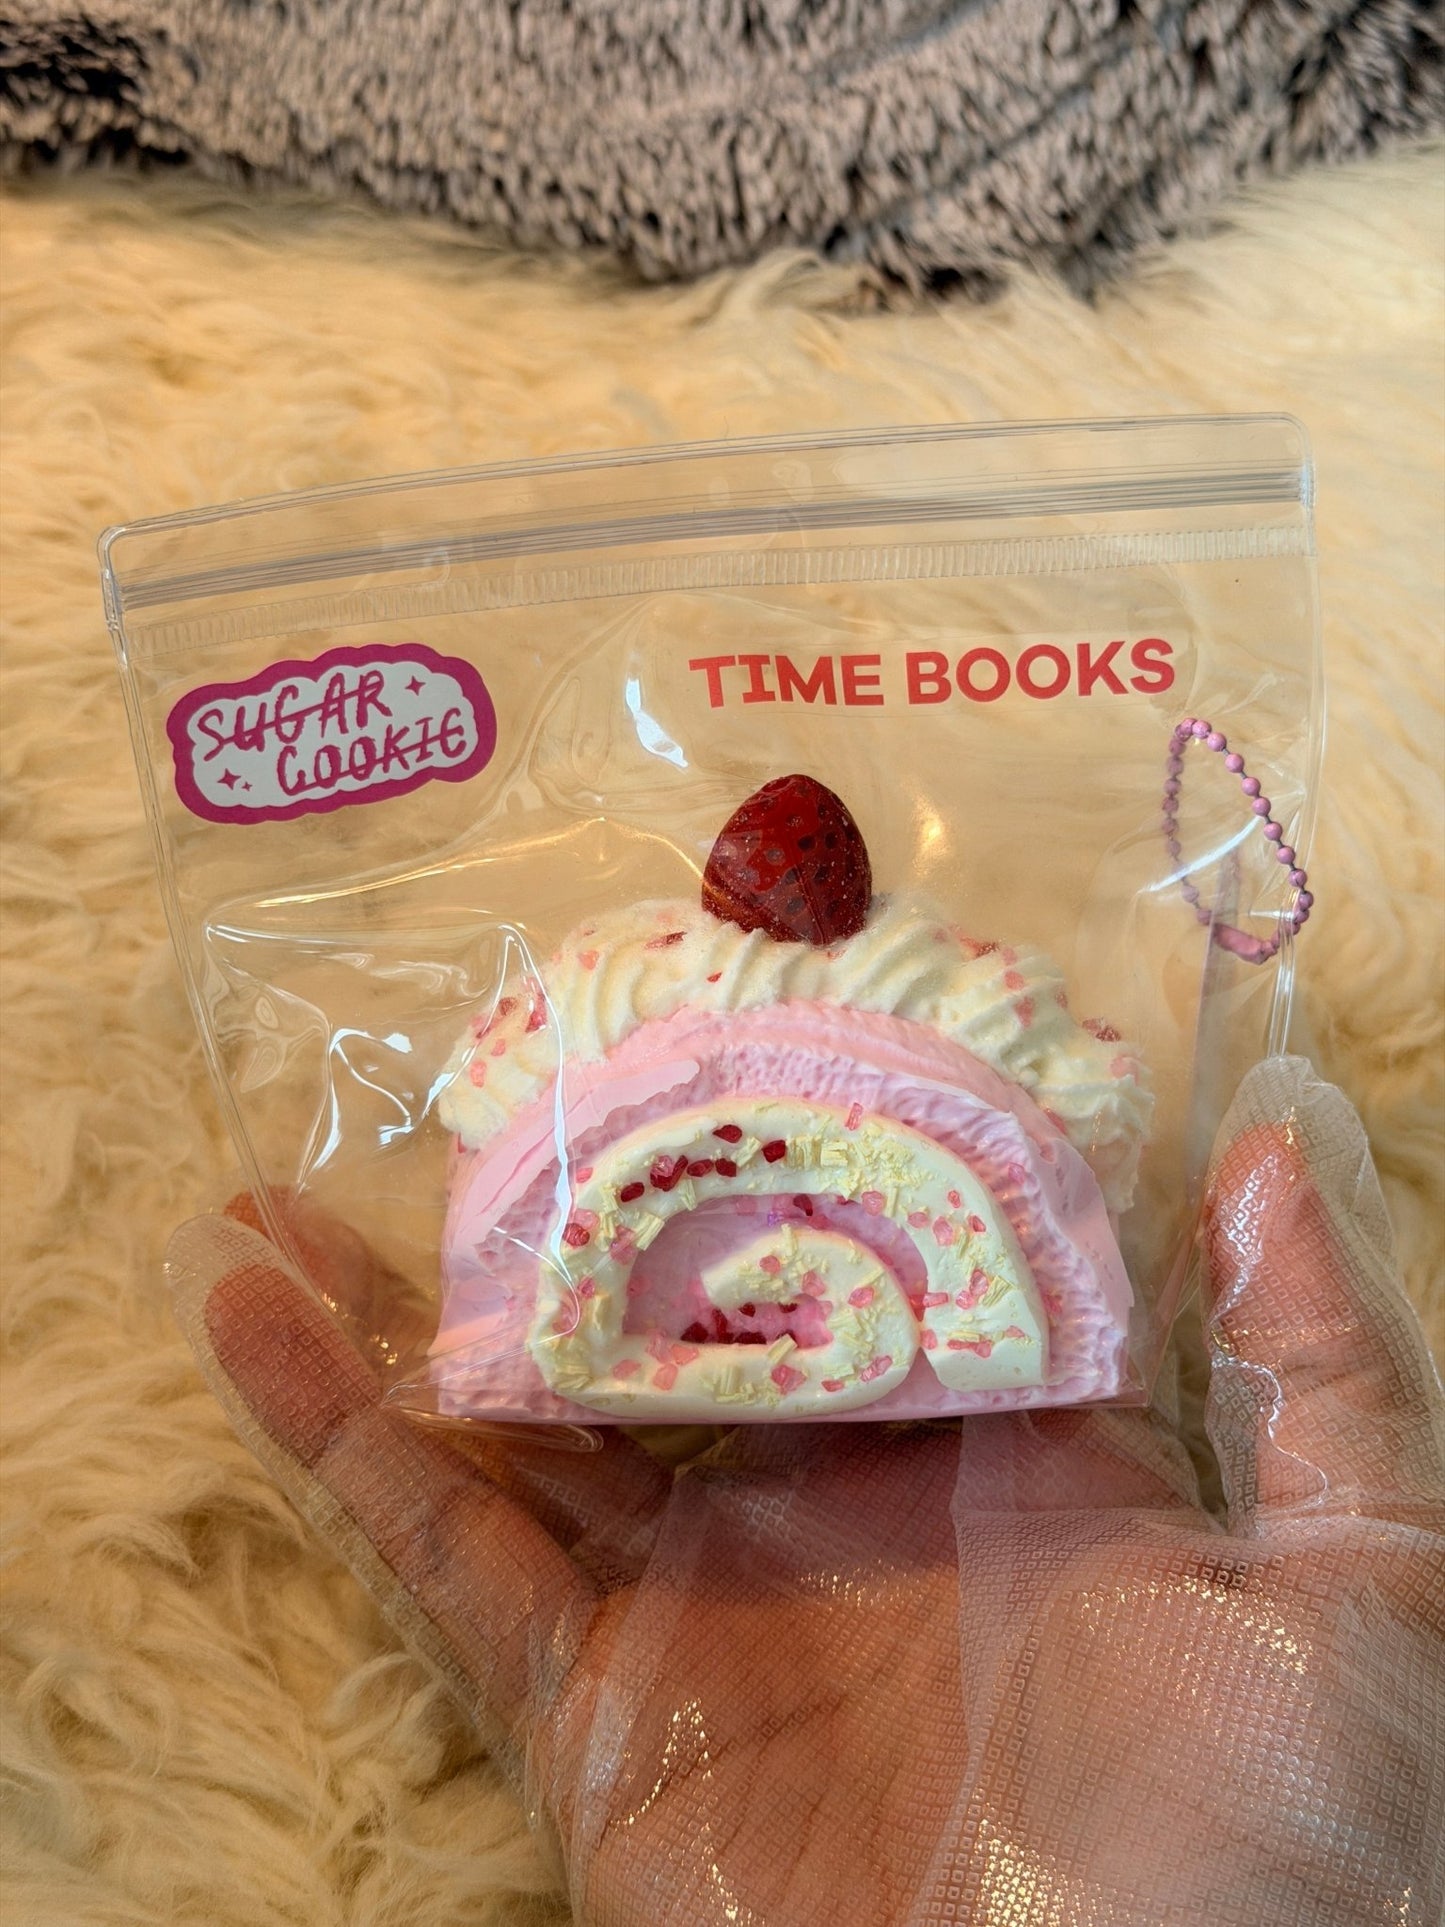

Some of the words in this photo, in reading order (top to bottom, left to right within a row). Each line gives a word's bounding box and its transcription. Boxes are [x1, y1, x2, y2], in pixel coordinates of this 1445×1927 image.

[197, 670, 392, 761] SUGAR
[689, 653, 885, 708] TIME
[905, 638, 1176, 705] BOOKS
[277, 707, 469, 796] COOKIE
